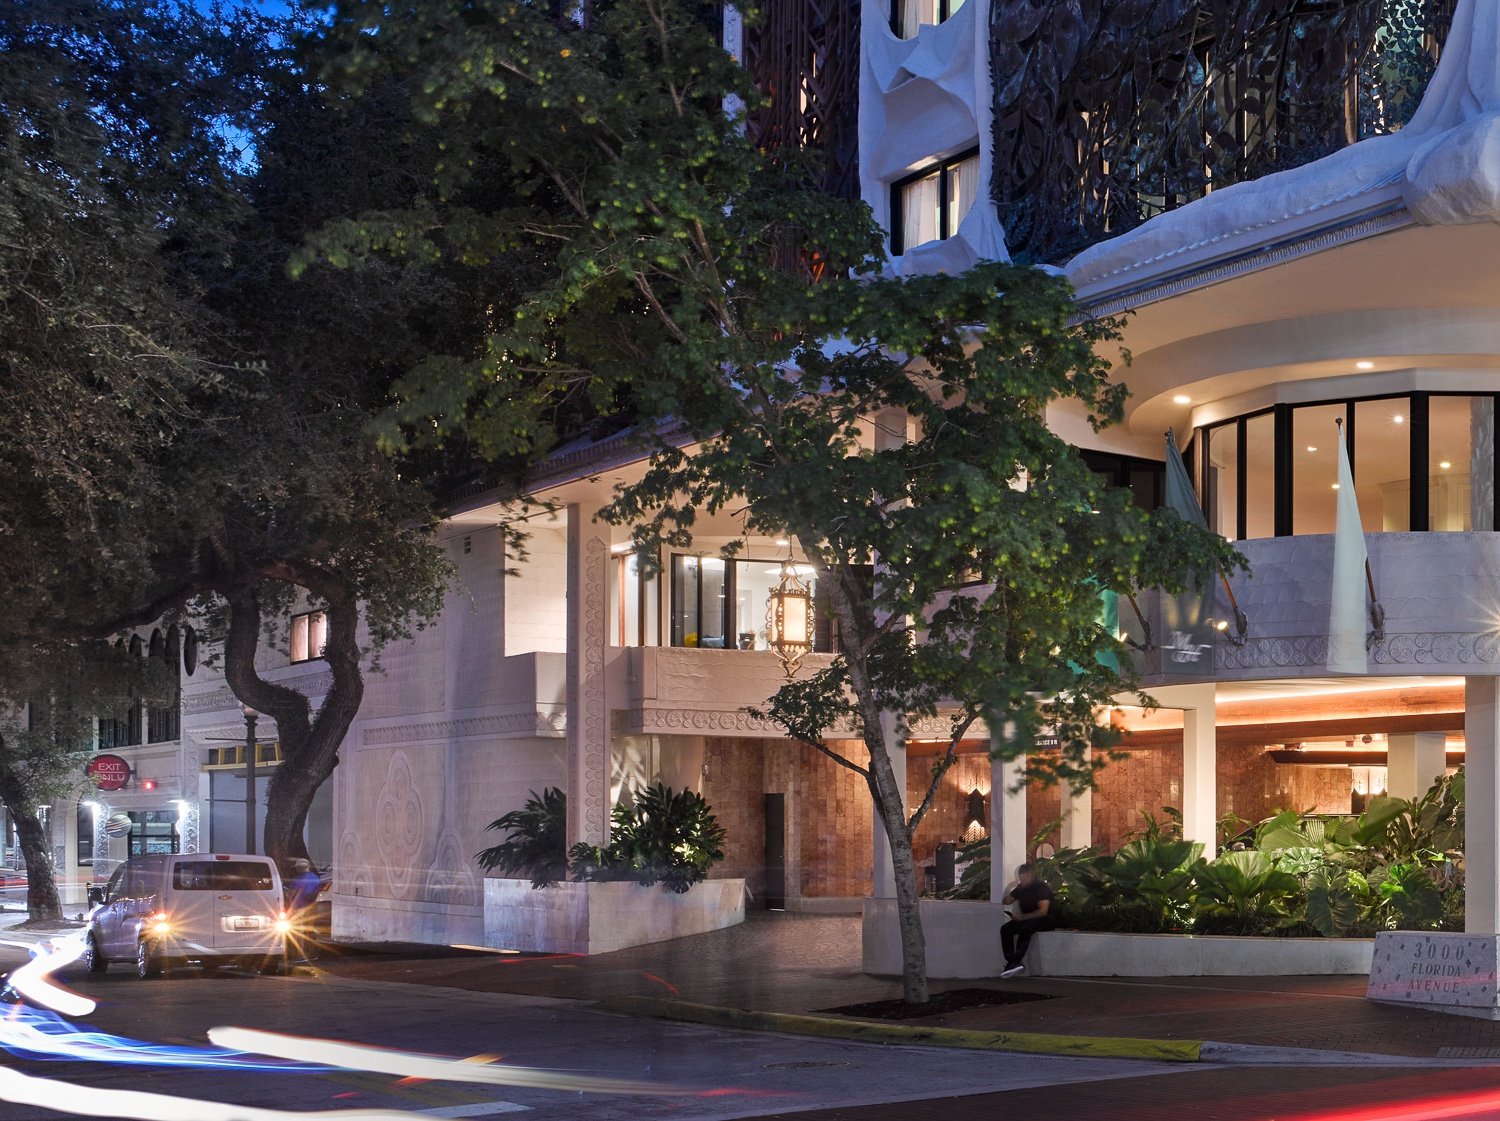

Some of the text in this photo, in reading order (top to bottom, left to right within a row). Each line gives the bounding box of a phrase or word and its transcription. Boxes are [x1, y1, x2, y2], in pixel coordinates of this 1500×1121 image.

[98, 763, 122, 771] EXIT
[1414, 942, 1465, 961] 3000
[1411, 962, 1461, 977] FLORIDA
[1408, 978, 1460, 994] AVENUE
